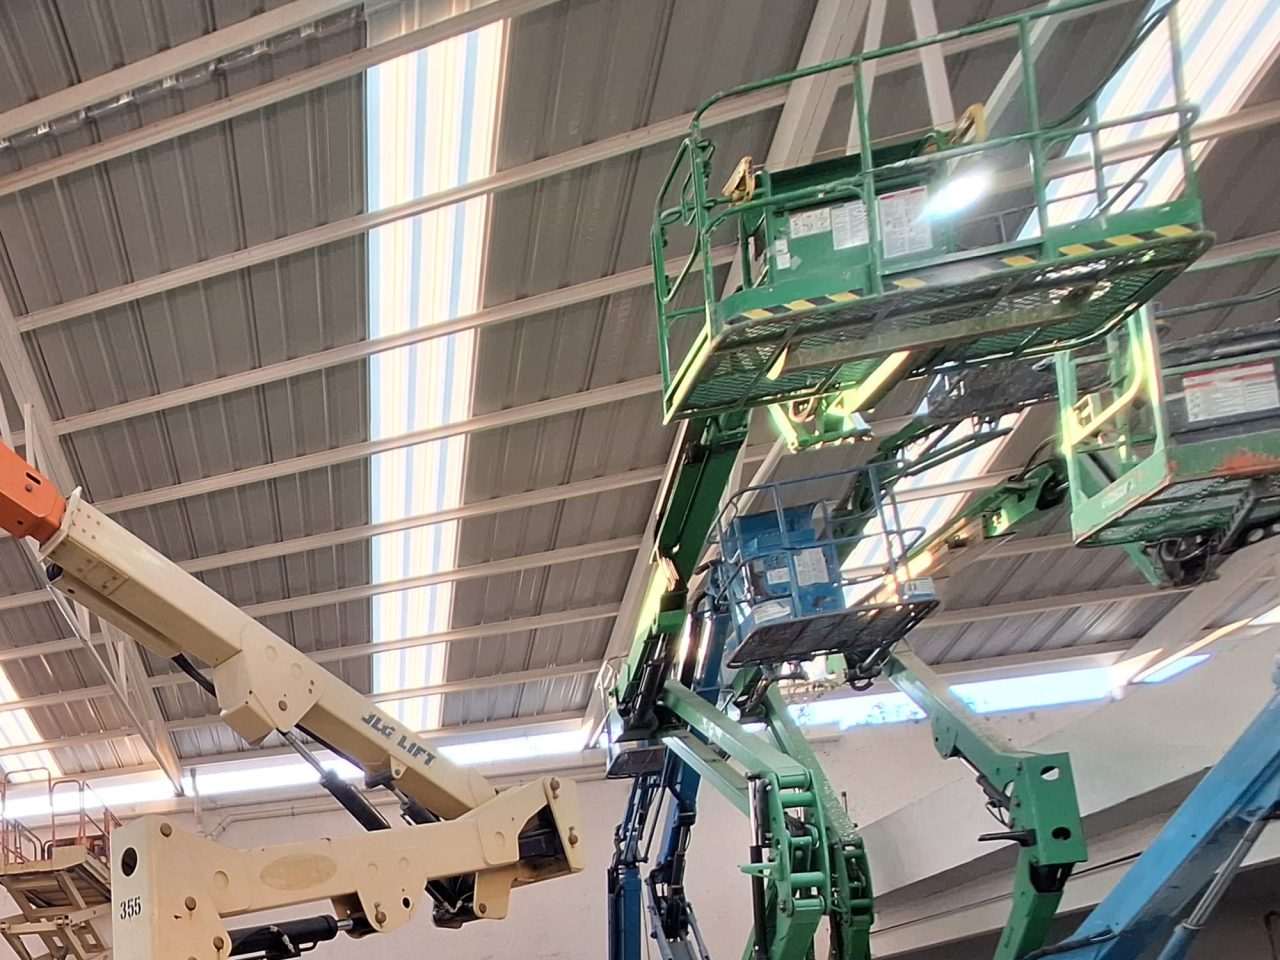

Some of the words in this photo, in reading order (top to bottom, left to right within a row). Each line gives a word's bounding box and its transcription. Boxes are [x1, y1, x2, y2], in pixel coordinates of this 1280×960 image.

[361, 713, 395, 738] JLG
[397, 735, 436, 766] LIFT
[120, 896, 141, 919] 355
